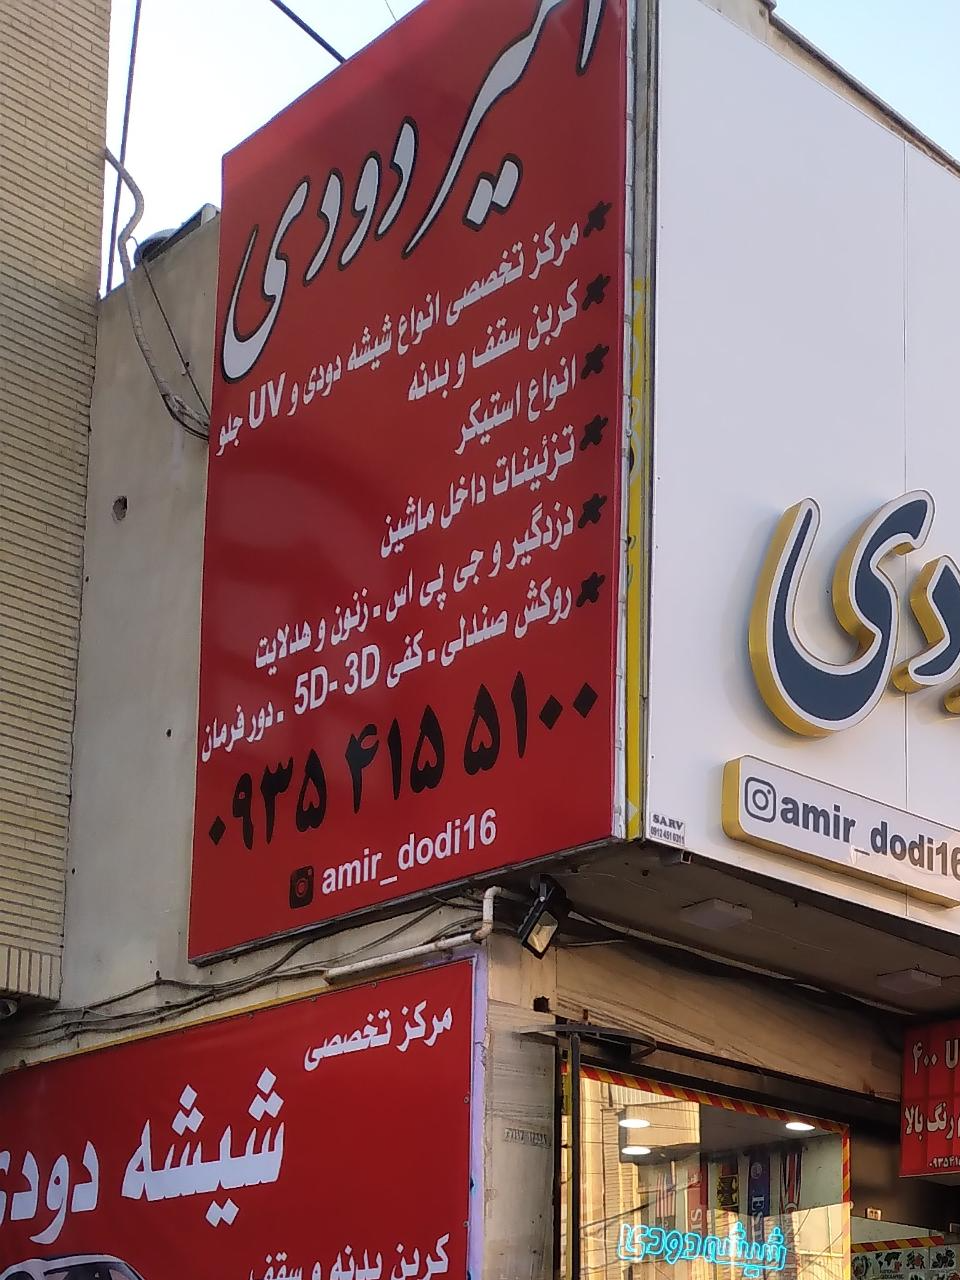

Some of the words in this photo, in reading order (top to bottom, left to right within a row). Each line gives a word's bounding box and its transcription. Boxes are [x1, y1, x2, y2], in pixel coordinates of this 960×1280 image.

[222, 118, 419, 384] دودی
[529, 222, 578, 279] مرکز
[446, 241, 524, 326] تخصصی
[347, 314, 392, 371] شیشه
[398, 291, 439, 355] انواع
[472, 317, 521, 368] سقف
[528, 279, 578, 350] کربن
[287, 381, 299, 416] و
[303, 354, 342, 405] دودی
[408, 358, 449, 400] بدنه
[453, 352, 466, 389] و
[528, 353, 576, 422] انواع
[249, 372, 286, 429] UV
[454, 381, 520, 455] استیکر
[215, 412, 243, 456] جلو
[492, 424, 575, 496] تزئینات
[381, 496, 435, 558] ماشین
[441, 472, 486, 529] داخل
[488, 540, 502, 577] و
[506, 502, 574, 570] دزدگیر
[386, 568, 413, 622] اس
[420, 563, 447, 611] پی
[453, 550, 484, 592] جی
[314, 617, 326, 652] و
[330, 587, 368, 646] زنون
[440, 604, 508, 667] صندلی
[514, 577, 572, 639] روکش
[255, 620, 312, 676] هدلایت
[344, 645, 380, 695] 3D
[386, 629, 424, 688] کفی
[652, 813, 684, 831] SARV
[322, 808, 497, 895] amir_dodi16
[304, 1008, 392, 1072] تخصصی
[396, 1000, 452, 1052] مرکز
[121, 1066, 285, 1228] شیشه
[904, 1104, 924, 1141] بالا
[926, 1101, 953, 1140] رنگ
[617, 1223, 702, 1265] دودی
[703, 1221, 787, 1279] شیشه
